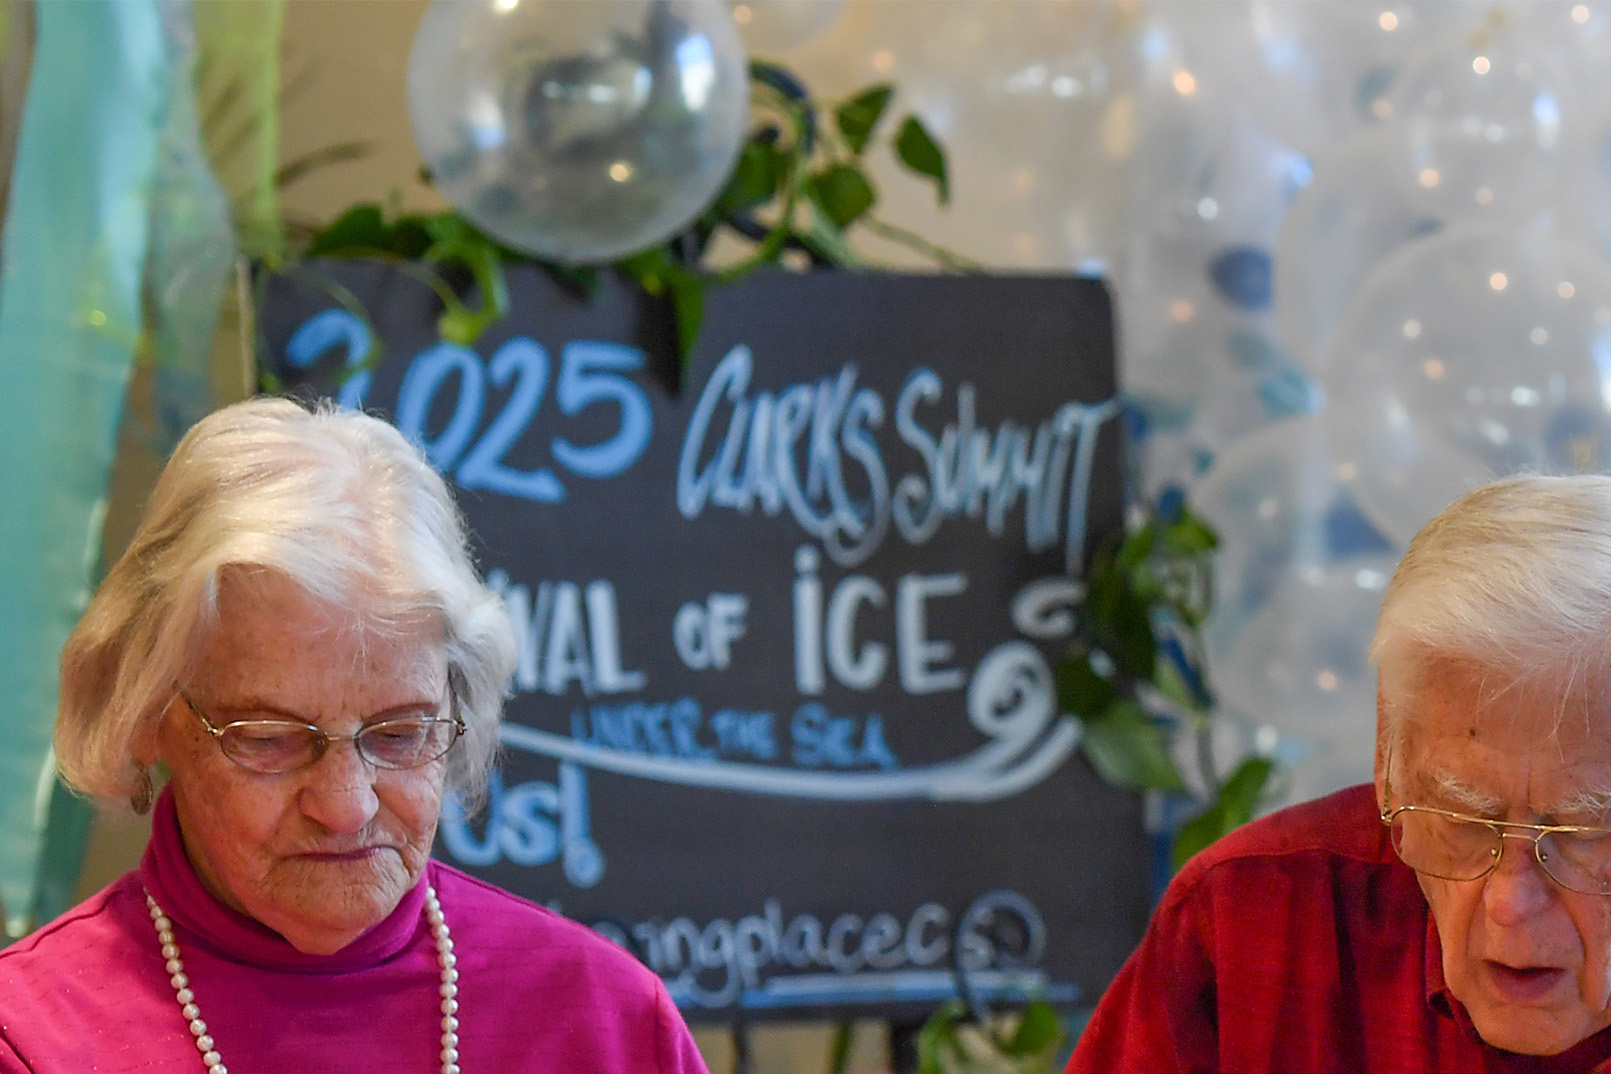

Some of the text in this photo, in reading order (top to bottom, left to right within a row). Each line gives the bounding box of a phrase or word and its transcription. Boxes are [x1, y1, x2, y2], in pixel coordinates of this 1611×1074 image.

[286, 308, 653, 503] 2025
[673, 592, 749, 671] OF
[570, 696, 899, 771] UNDER THE SEA
